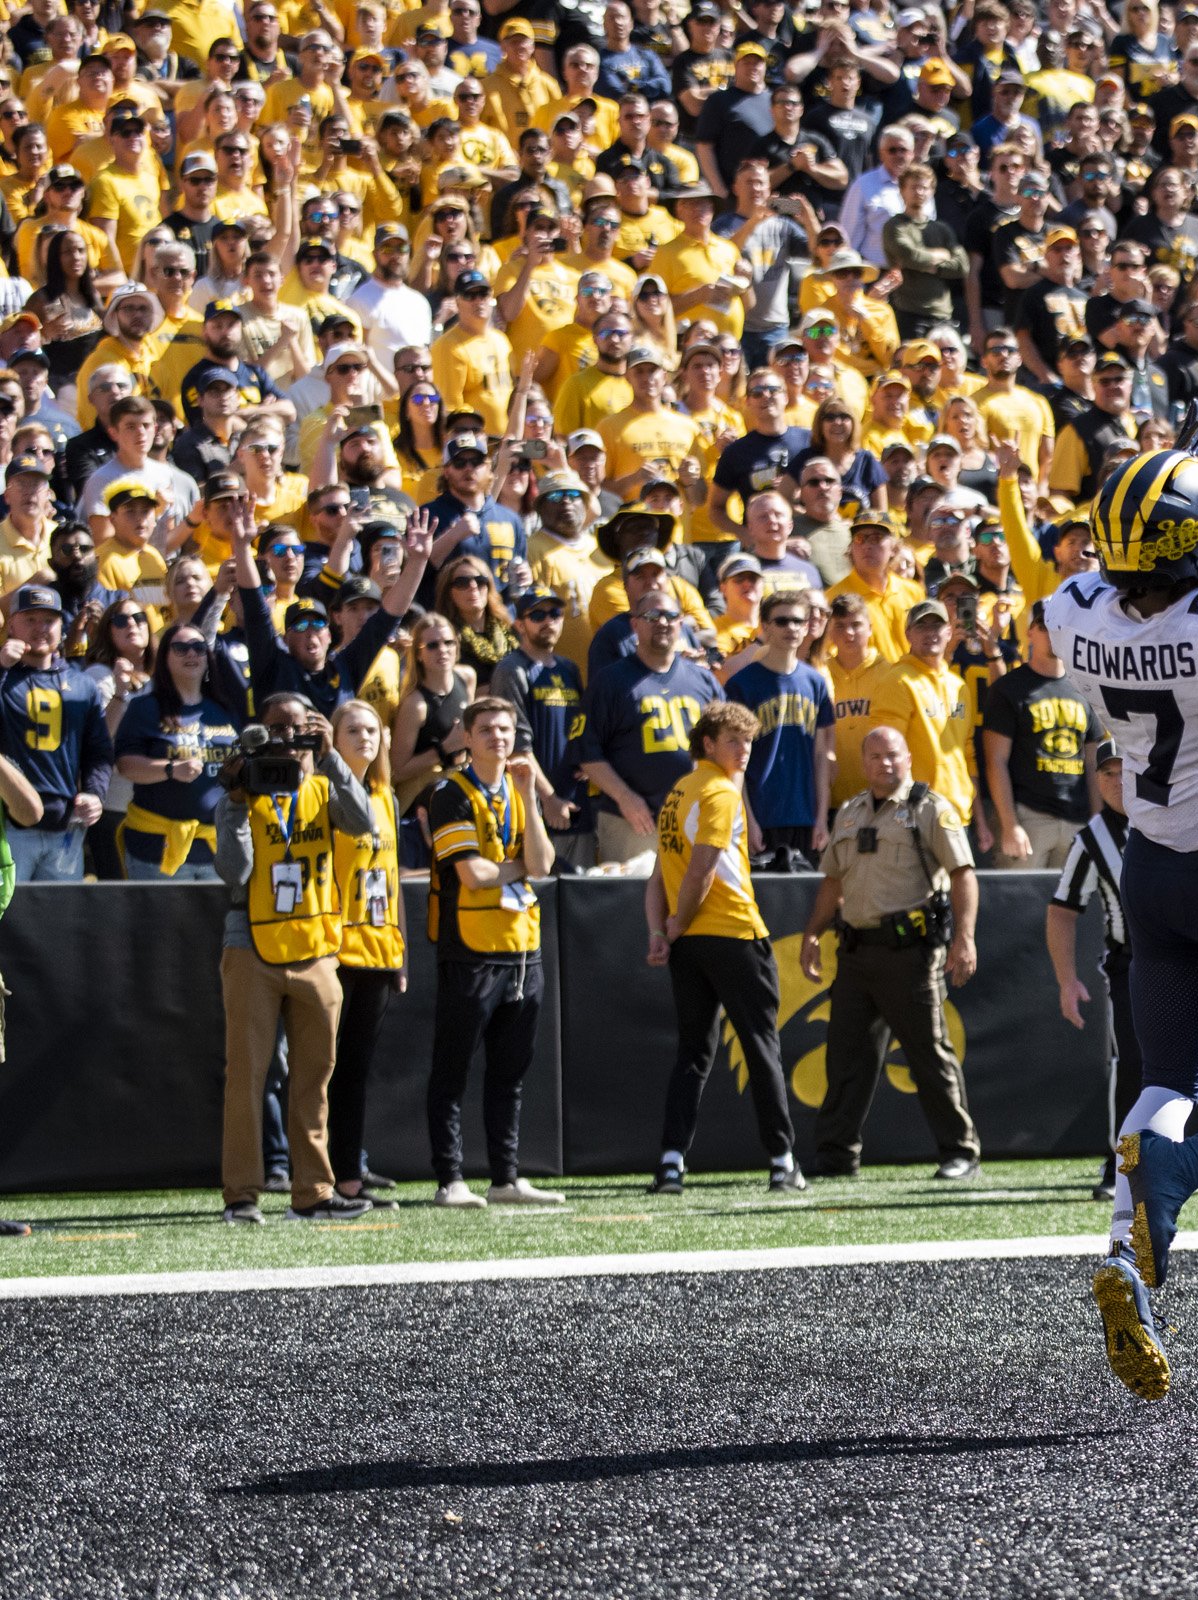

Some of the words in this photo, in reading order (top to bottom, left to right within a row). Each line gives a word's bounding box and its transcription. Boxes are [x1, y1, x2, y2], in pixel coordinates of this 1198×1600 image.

[1073, 634, 1197, 682] EDWARDS
[25, 687, 63, 753] 9
[641, 694, 701, 755] 20
[1029, 696, 1088, 733] IOWA
[167, 744, 241, 763] MICHIG
[1099, 684, 1185, 808] 7
